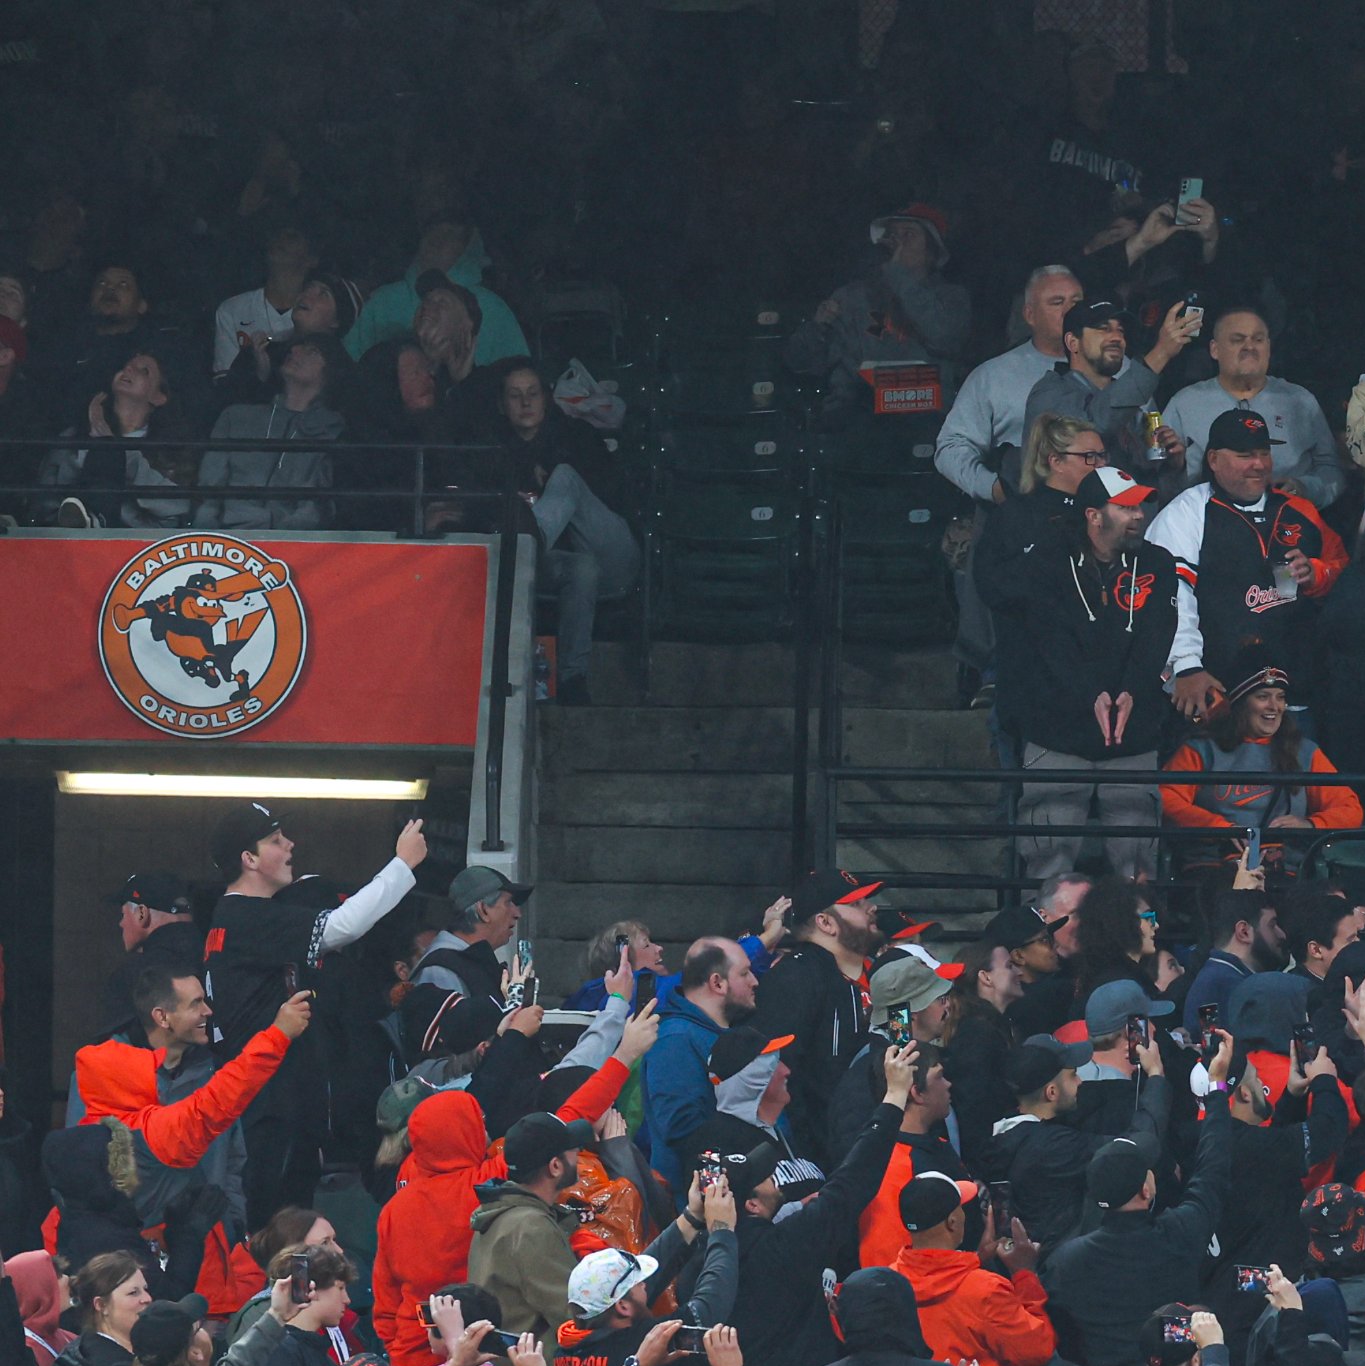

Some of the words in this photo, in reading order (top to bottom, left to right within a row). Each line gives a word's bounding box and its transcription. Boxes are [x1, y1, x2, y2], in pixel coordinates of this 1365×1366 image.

[884, 388, 934, 402] BMORE
[125, 540, 280, 592] BALTIMORE
[138, 692, 263, 730] ORIOLES
